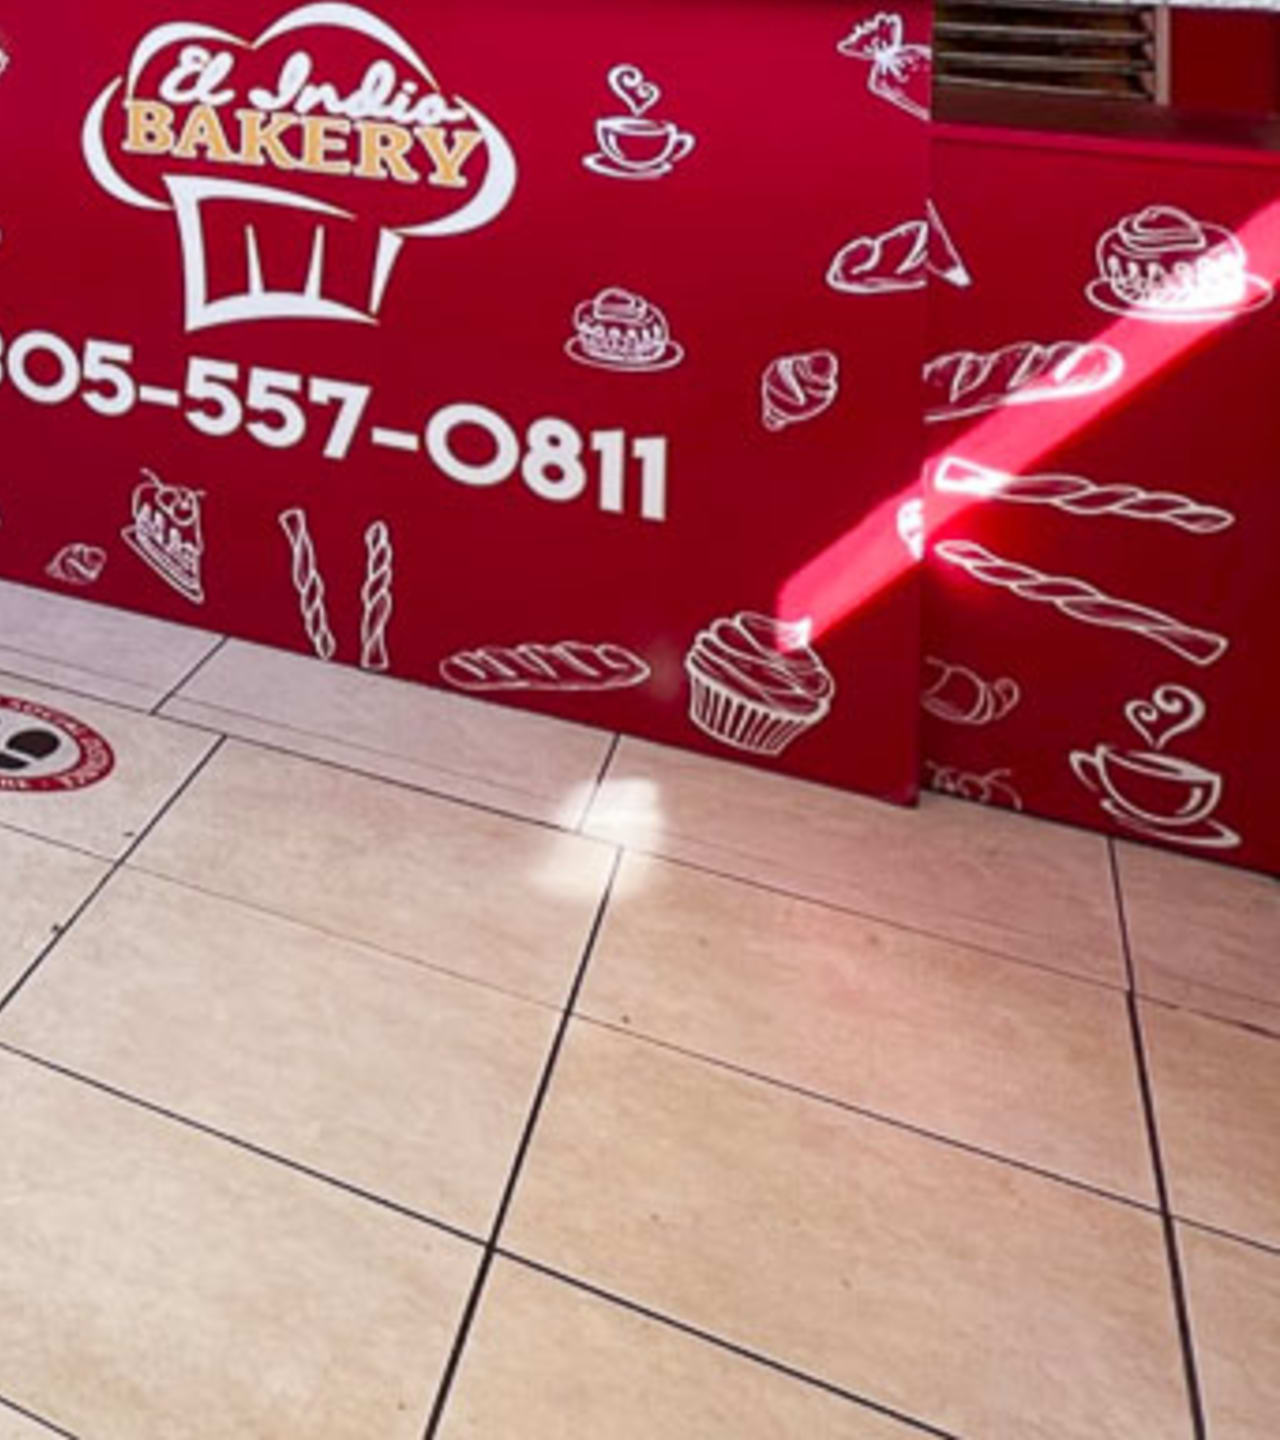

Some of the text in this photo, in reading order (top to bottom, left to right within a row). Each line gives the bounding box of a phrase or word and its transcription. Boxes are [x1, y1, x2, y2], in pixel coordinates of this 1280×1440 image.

[158, 45, 470, 124] El Indio
[122, 99, 483, 188] BAKERY
